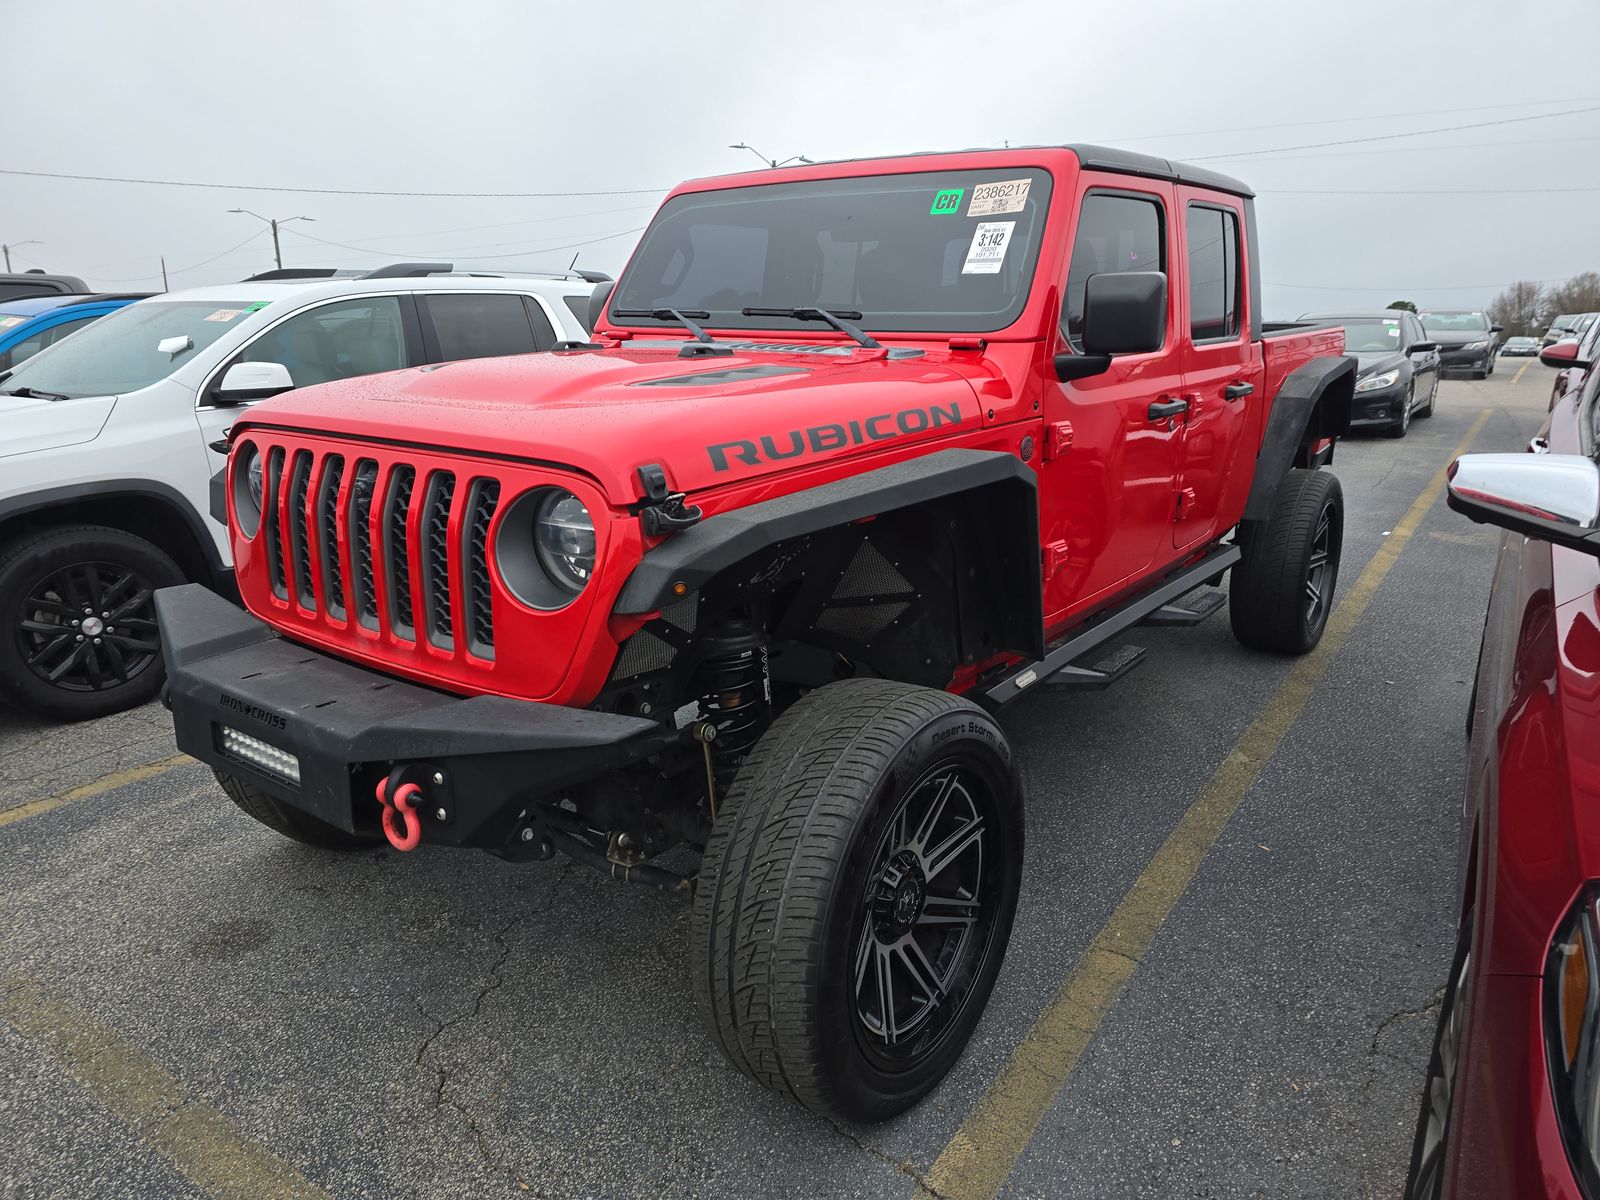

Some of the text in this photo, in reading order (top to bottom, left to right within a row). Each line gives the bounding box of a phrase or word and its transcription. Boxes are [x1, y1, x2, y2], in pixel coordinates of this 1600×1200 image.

[974, 183, 1030, 200] 2386217
[936, 194, 959, 209] CR
[978, 233, 1004, 247] 3:142
[707, 402, 961, 472] RUBICON
[931, 721, 994, 743] Desert Storm
